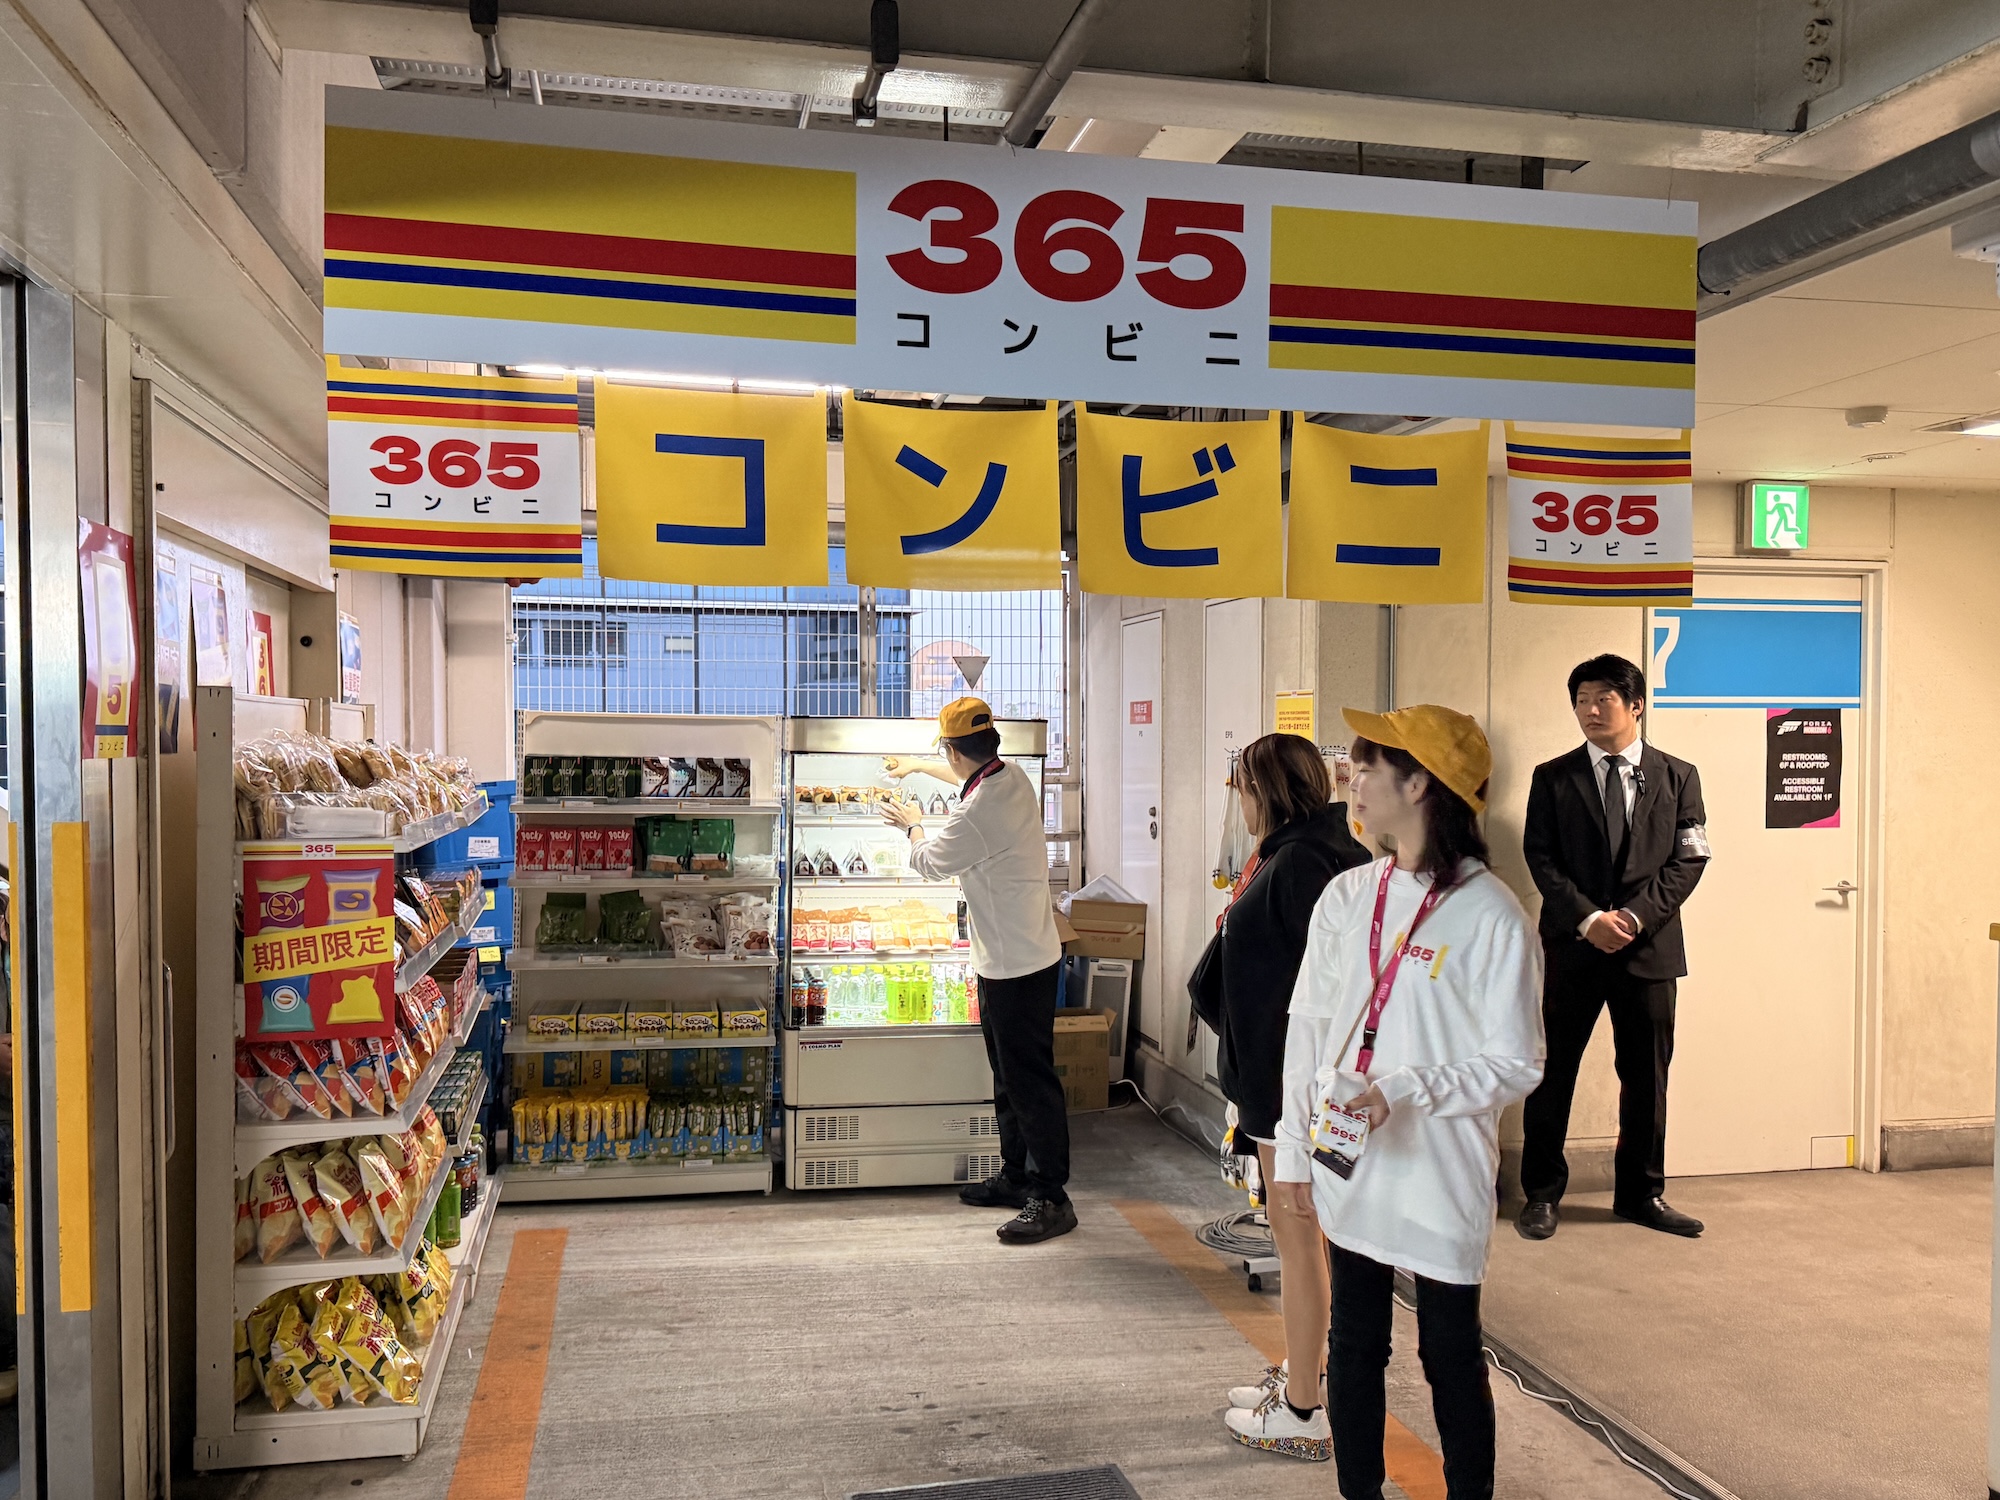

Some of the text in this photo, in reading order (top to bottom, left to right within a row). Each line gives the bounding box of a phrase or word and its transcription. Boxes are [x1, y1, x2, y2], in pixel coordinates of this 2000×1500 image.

[886, 179, 1247, 310] 365
[896, 312, 1241, 366] コンビニ
[369, 435, 541, 491] 365
[375, 492, 539, 514] コンビニ
[1531, 491, 1660, 536] 365
[1535, 539, 1659, 557] コンビニ
[1225, 730, 1233, 739] EPS
[1782, 753, 1828, 761] RESTROOMS:
[1796, 761, 1830, 769] ROOFTOP
[1774, 794, 1811, 802] AVAILABLE
[305, 844, 334, 853] 365
[251, 925, 388, 974] 期間限定
[1403, 942, 1435, 962] 365
